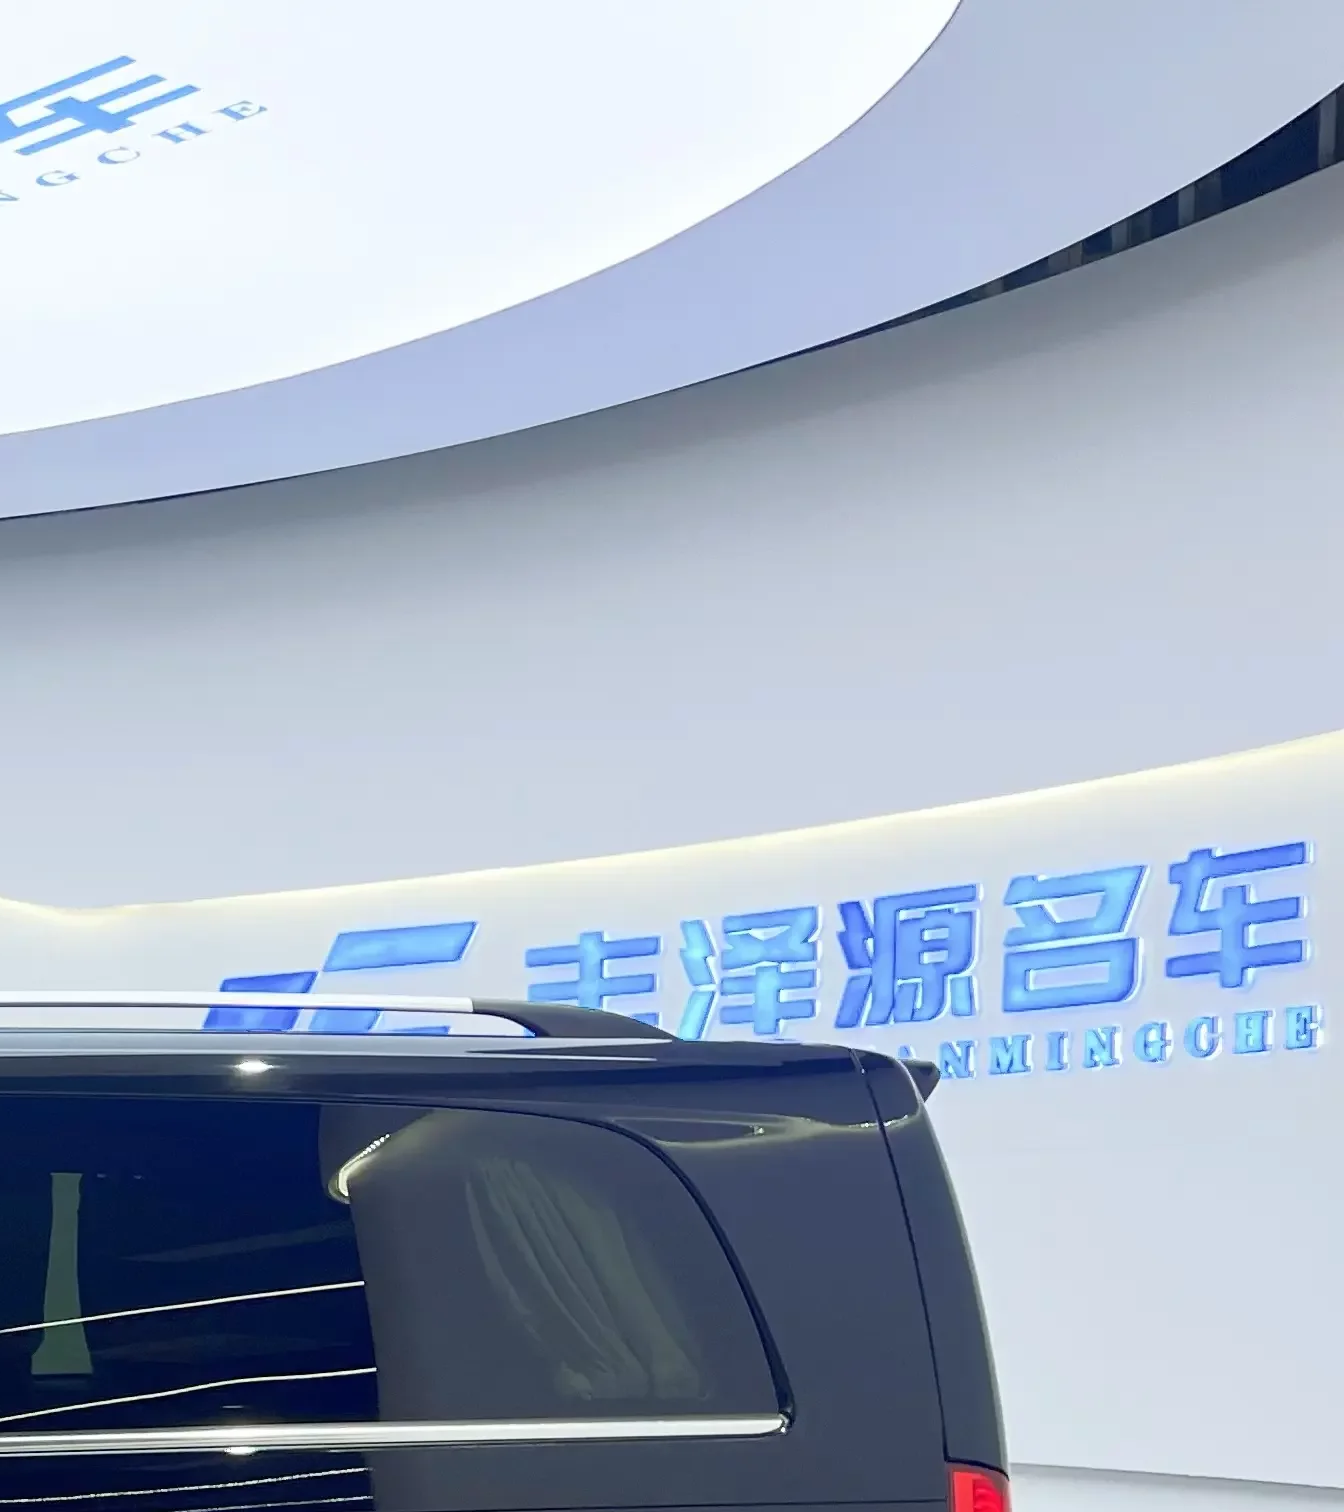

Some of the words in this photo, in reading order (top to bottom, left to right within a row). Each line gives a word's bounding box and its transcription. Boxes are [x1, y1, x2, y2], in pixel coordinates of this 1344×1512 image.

[524, 840, 1314, 1042] 丰泽源名车
